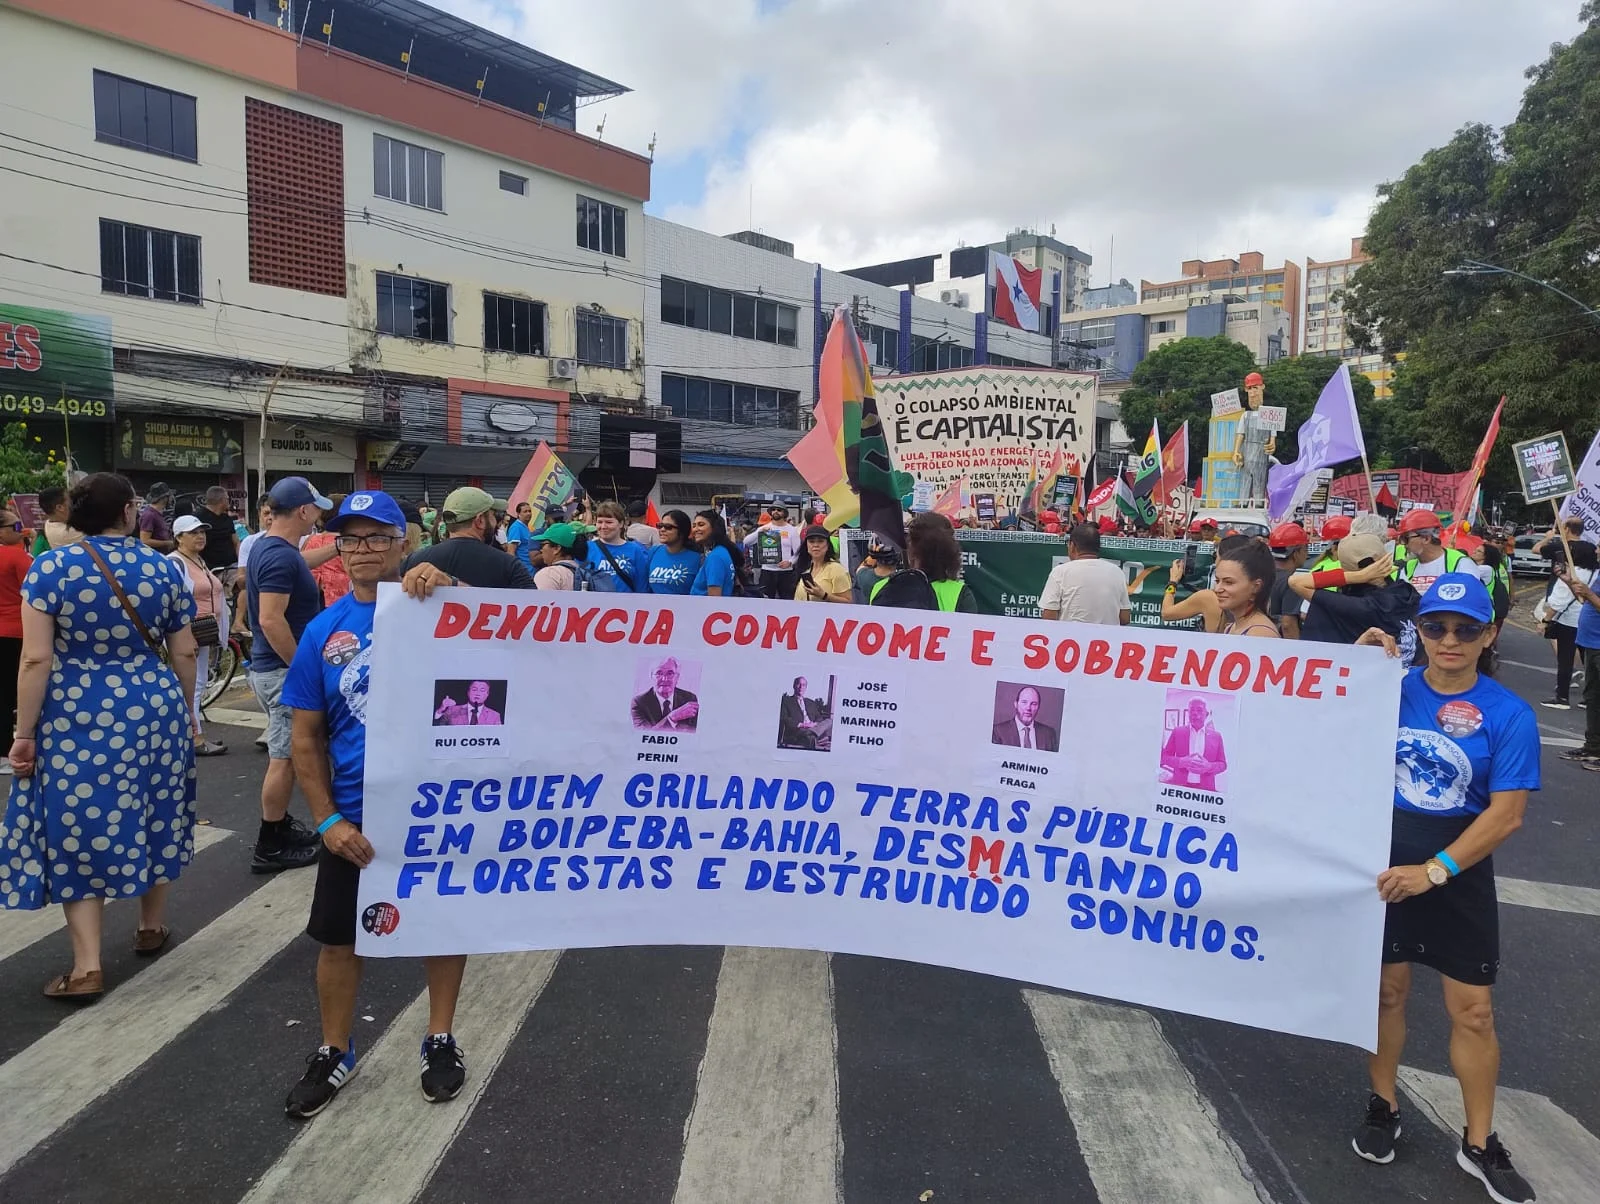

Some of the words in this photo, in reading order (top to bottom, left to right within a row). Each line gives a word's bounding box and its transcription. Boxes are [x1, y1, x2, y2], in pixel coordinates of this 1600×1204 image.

[0, 394, 106, 417] 049-4949
[895, 402, 905, 415] O
[909, 396, 980, 414] COLAPSO
[984, 394, 1077, 414] AMBIENTAL
[144, 422, 169, 434] SHOP
[895, 416, 912, 444] É
[916, 413, 1077, 442] CAPITALISTA
[271, 439, 311, 451] EDUARDO
[1521, 441, 1560, 458] TRUMP
[900, 451, 928, 462] LULA,
[931, 447, 985, 459] TRANSIÇÃO
[990, 446, 1051, 458] ENERGÉTCA
[904, 458, 954, 471] PETRÓLEO
[956, 460, 971, 468] NO
[650, 566, 682, 580] AYCC
[1009, 594, 1016, 604] A
[1004, 606, 1025, 617] SEM
[436, 601, 673, 644] DENÚNCIA
[703, 611, 799, 650] COM
[817, 618, 949, 661] NOME
[971, 630, 994, 666] E
[1023, 634, 1350, 699] SOBRENOME:
[842, 698, 898, 711] ROBERTO
[840, 716, 896, 729] MARINHO
[435, 738, 457, 748] RUI
[460, 737, 501, 748] COSTA
[641, 734, 678, 745] FABIO
[848, 735, 884, 746] FILHO
[637, 752, 679, 763] PERINI
[999, 776, 1036, 790] FRAGA
[1160, 788, 1224, 806] JERONIMO
[1155, 804, 1226, 824] RODRIGUES
[410, 773, 604, 819] SEGUEM
[624, 773, 835, 814] GRILANDO
[856, 782, 1031, 834] TERRAS
[1042, 805, 1239, 872] PÚBLICA
[403, 822, 475, 858] EM
[873, 826, 1202, 909] DESMATANDO
[396, 855, 673, 900] FLORESTAS
[696, 857, 726, 891] E
[744, 858, 1030, 919] DESTRUINDO
[1067, 892, 1265, 962] SONHOS.
